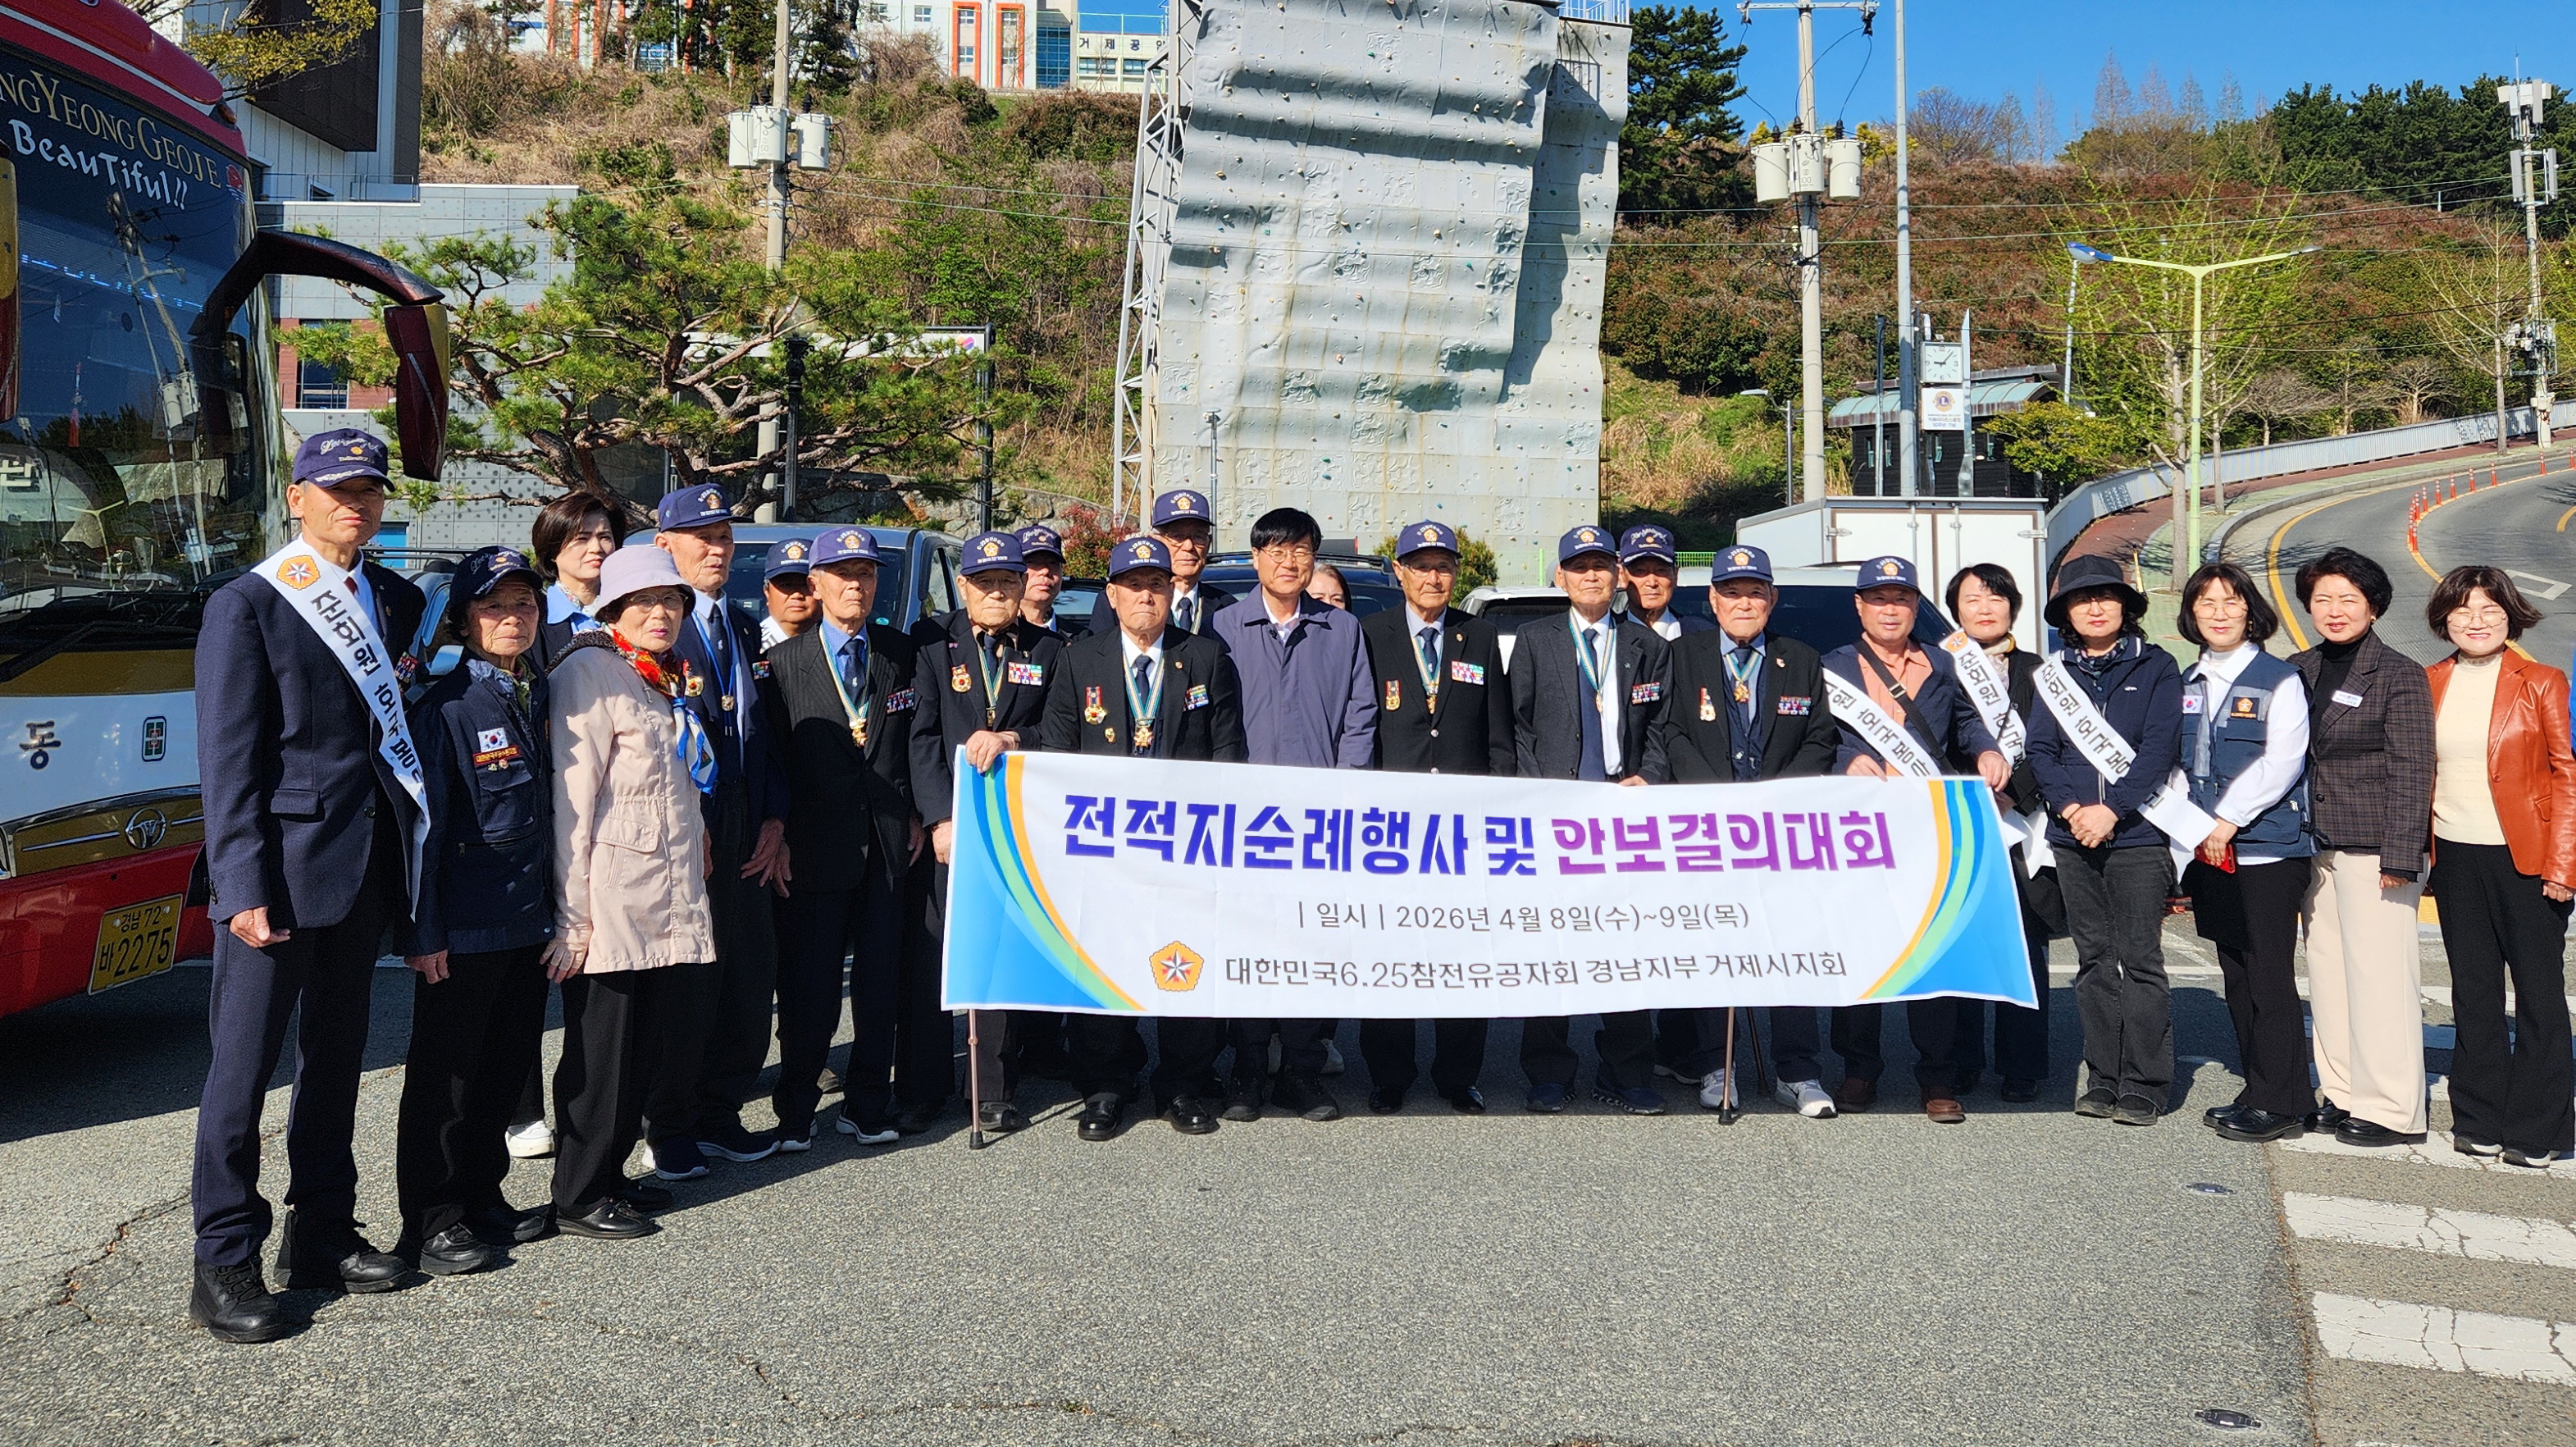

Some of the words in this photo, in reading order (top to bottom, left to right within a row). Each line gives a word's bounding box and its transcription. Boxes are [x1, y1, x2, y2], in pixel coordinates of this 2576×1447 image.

[310, 589, 382, 678] 준회원
[1958, 650, 2002, 707] 준회원
[2041, 663, 2082, 718] 준회원
[19, 719, 62, 770] 동
[1064, 793, 1469, 877] 전적지순례행사
[1484, 816, 1537, 876] 및
[1551, 810, 1896, 876] 안보결의대회
[120, 911, 142, 933] 경남
[144, 905, 162, 928] 72
[1317, 902, 1366, 929] 일시
[1397, 906, 1490, 932] 2026년
[1499, 906, 1542, 932] 4월
[1550, 902, 1748, 932] 8일(수)~9일(목)
[1225, 956, 1580, 988] 대한민국6.25참전유공자회
[1586, 955, 1700, 984] 경남지부
[1705, 951, 1847, 978] 거제시지회
